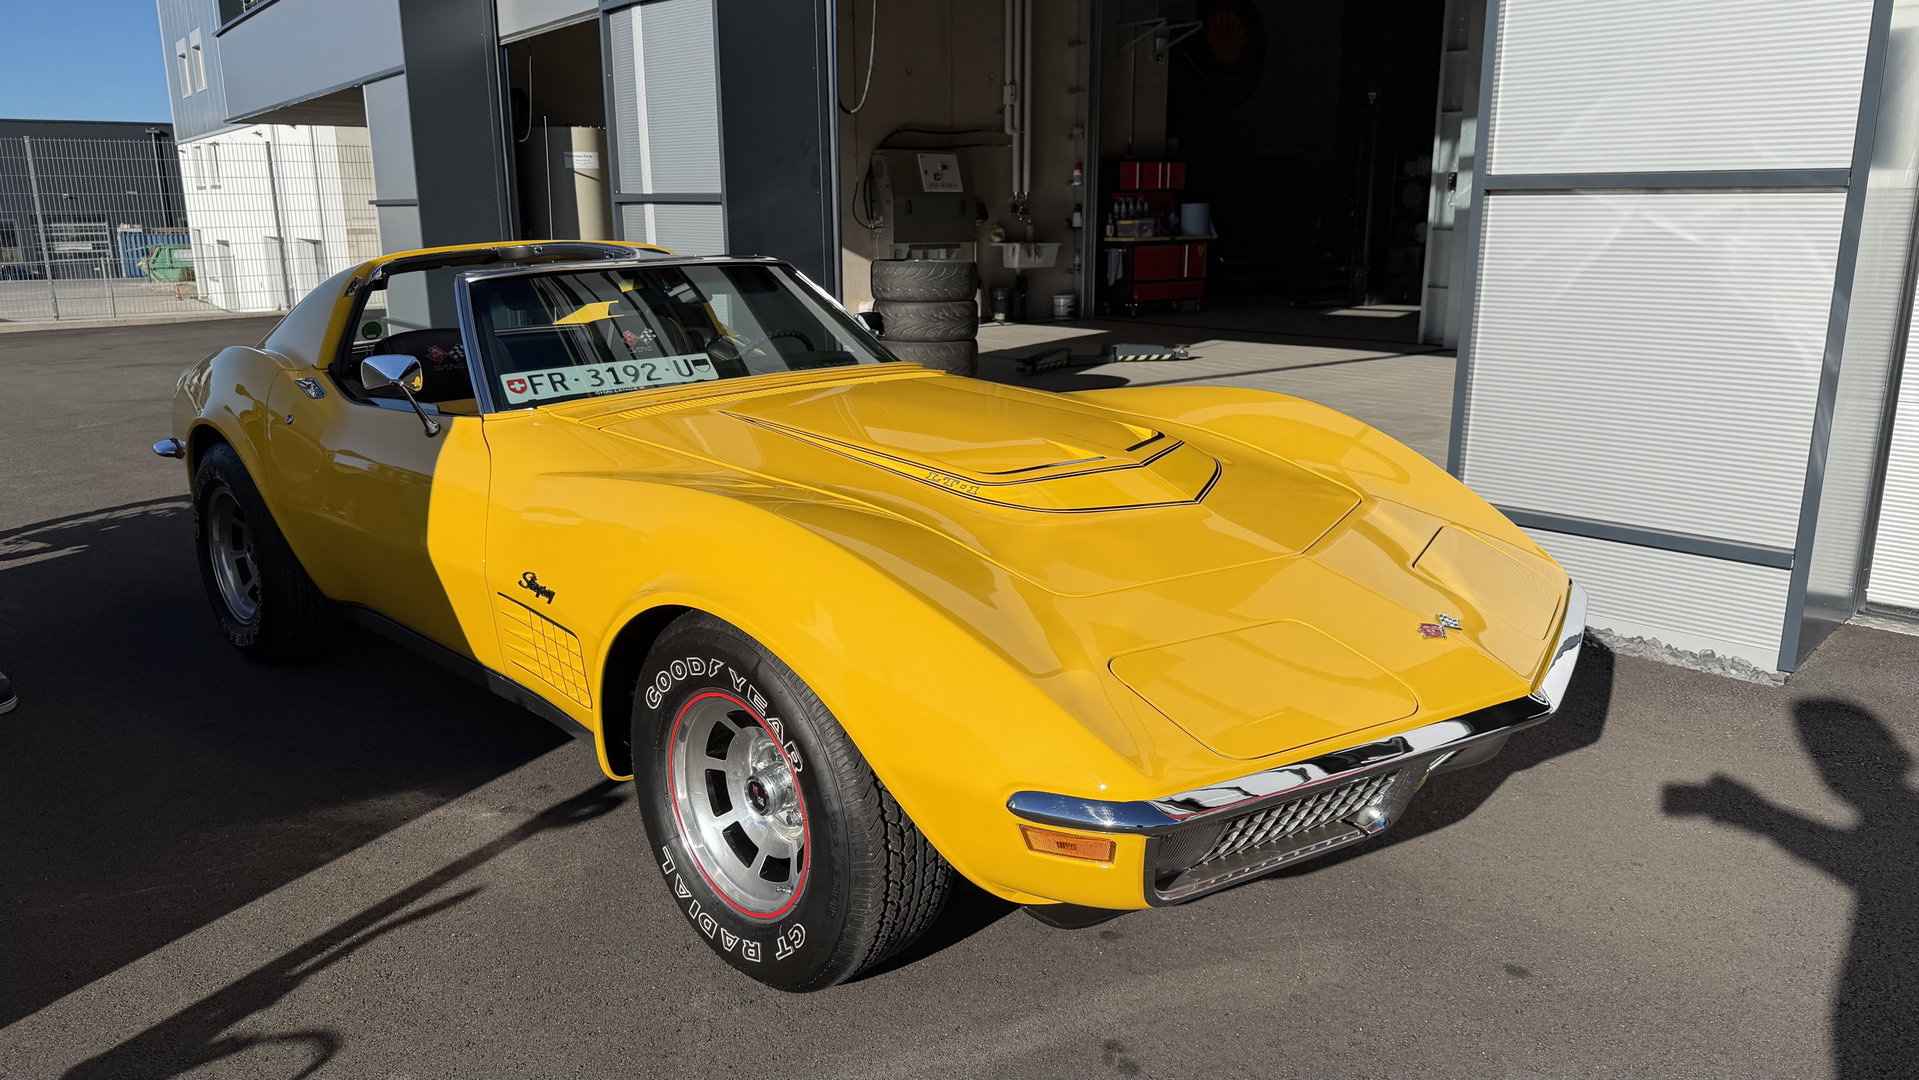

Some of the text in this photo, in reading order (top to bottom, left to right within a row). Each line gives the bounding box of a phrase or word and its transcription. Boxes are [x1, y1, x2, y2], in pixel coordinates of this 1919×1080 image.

[527, 358, 695, 395] FR 3192 U
[645, 656, 805, 775] GOODYEAR
[661, 844, 762, 963] RADIAL
[775, 922, 806, 962] GT
